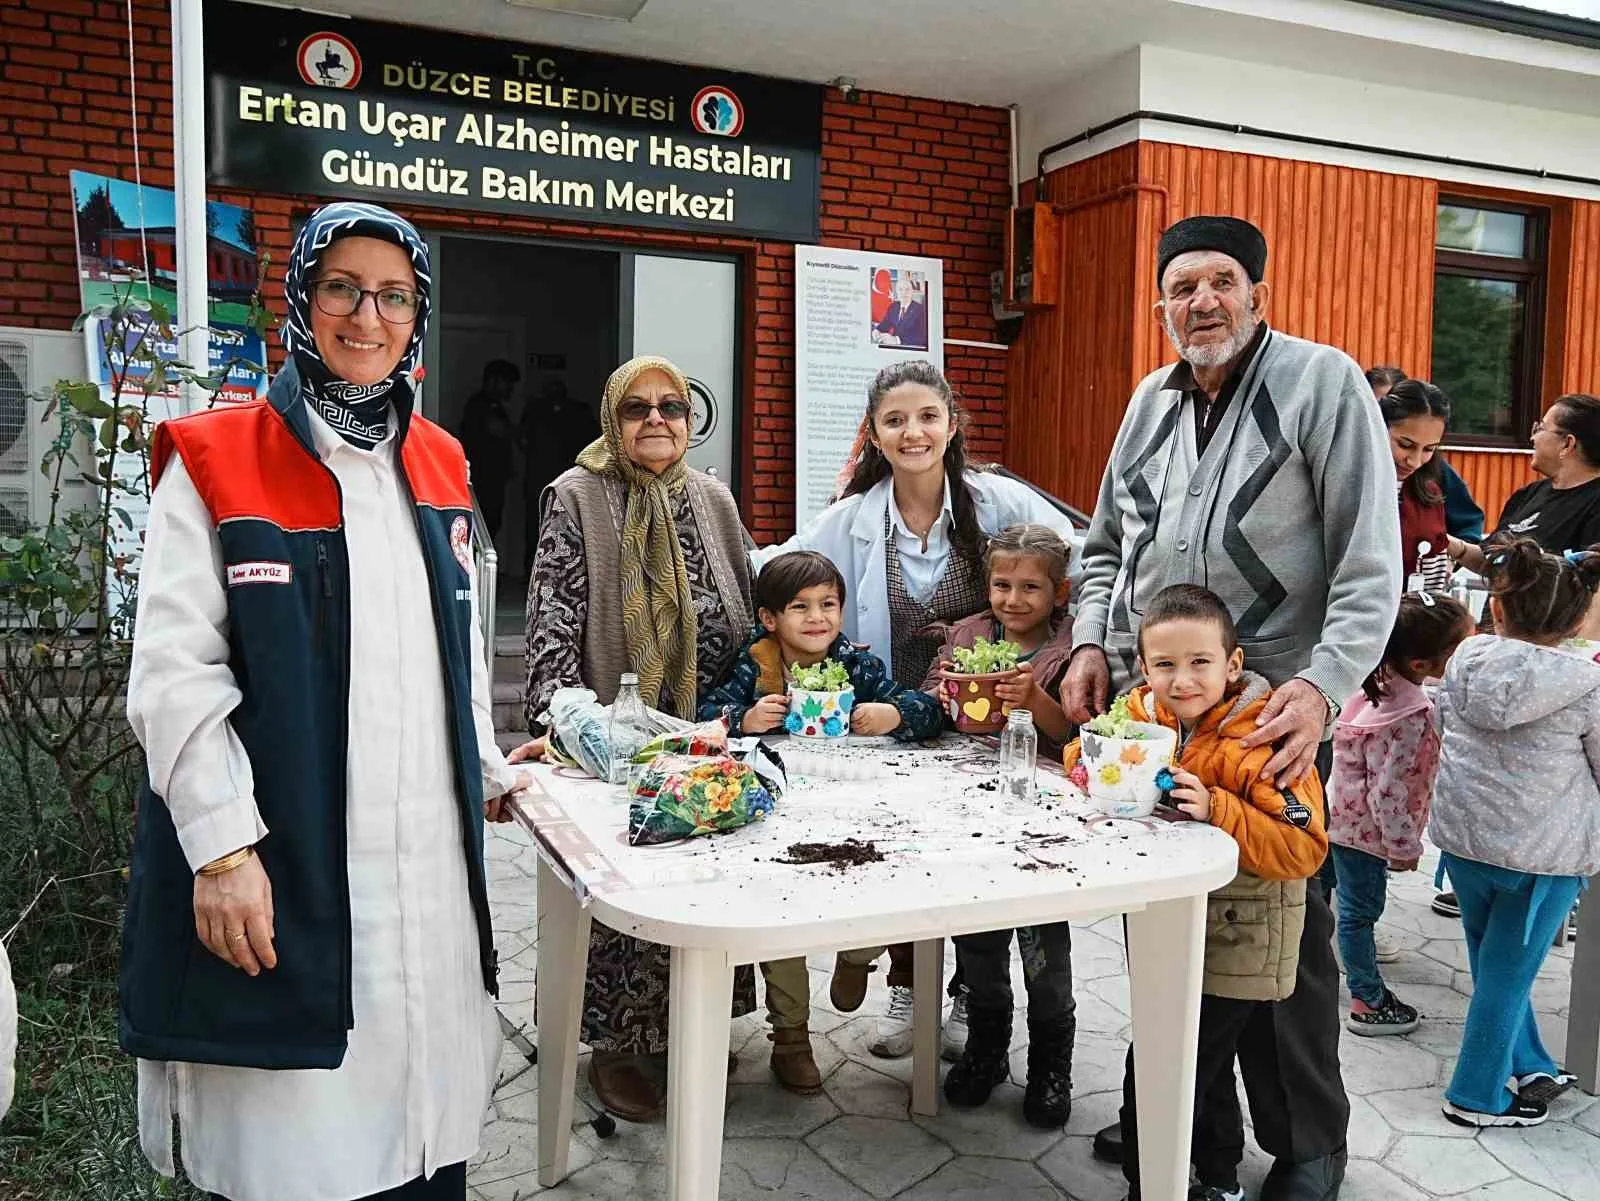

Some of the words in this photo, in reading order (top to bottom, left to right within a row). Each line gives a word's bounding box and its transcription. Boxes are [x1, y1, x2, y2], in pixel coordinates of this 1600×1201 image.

[383, 61, 492, 99] DÜZCE
[503, 79, 675, 121] BELEDİYESİ
[512, 54, 565, 82] T.C.
[239, 85, 346, 131] Ertan
[359, 100, 447, 147] Uçar
[455, 113, 639, 163] Alzheimer
[649, 135, 791, 181] Hastaları
[321, 149, 469, 200] Gündüz
[482, 166, 594, 209] Bakım
[605, 179, 734, 222] Merkezi
